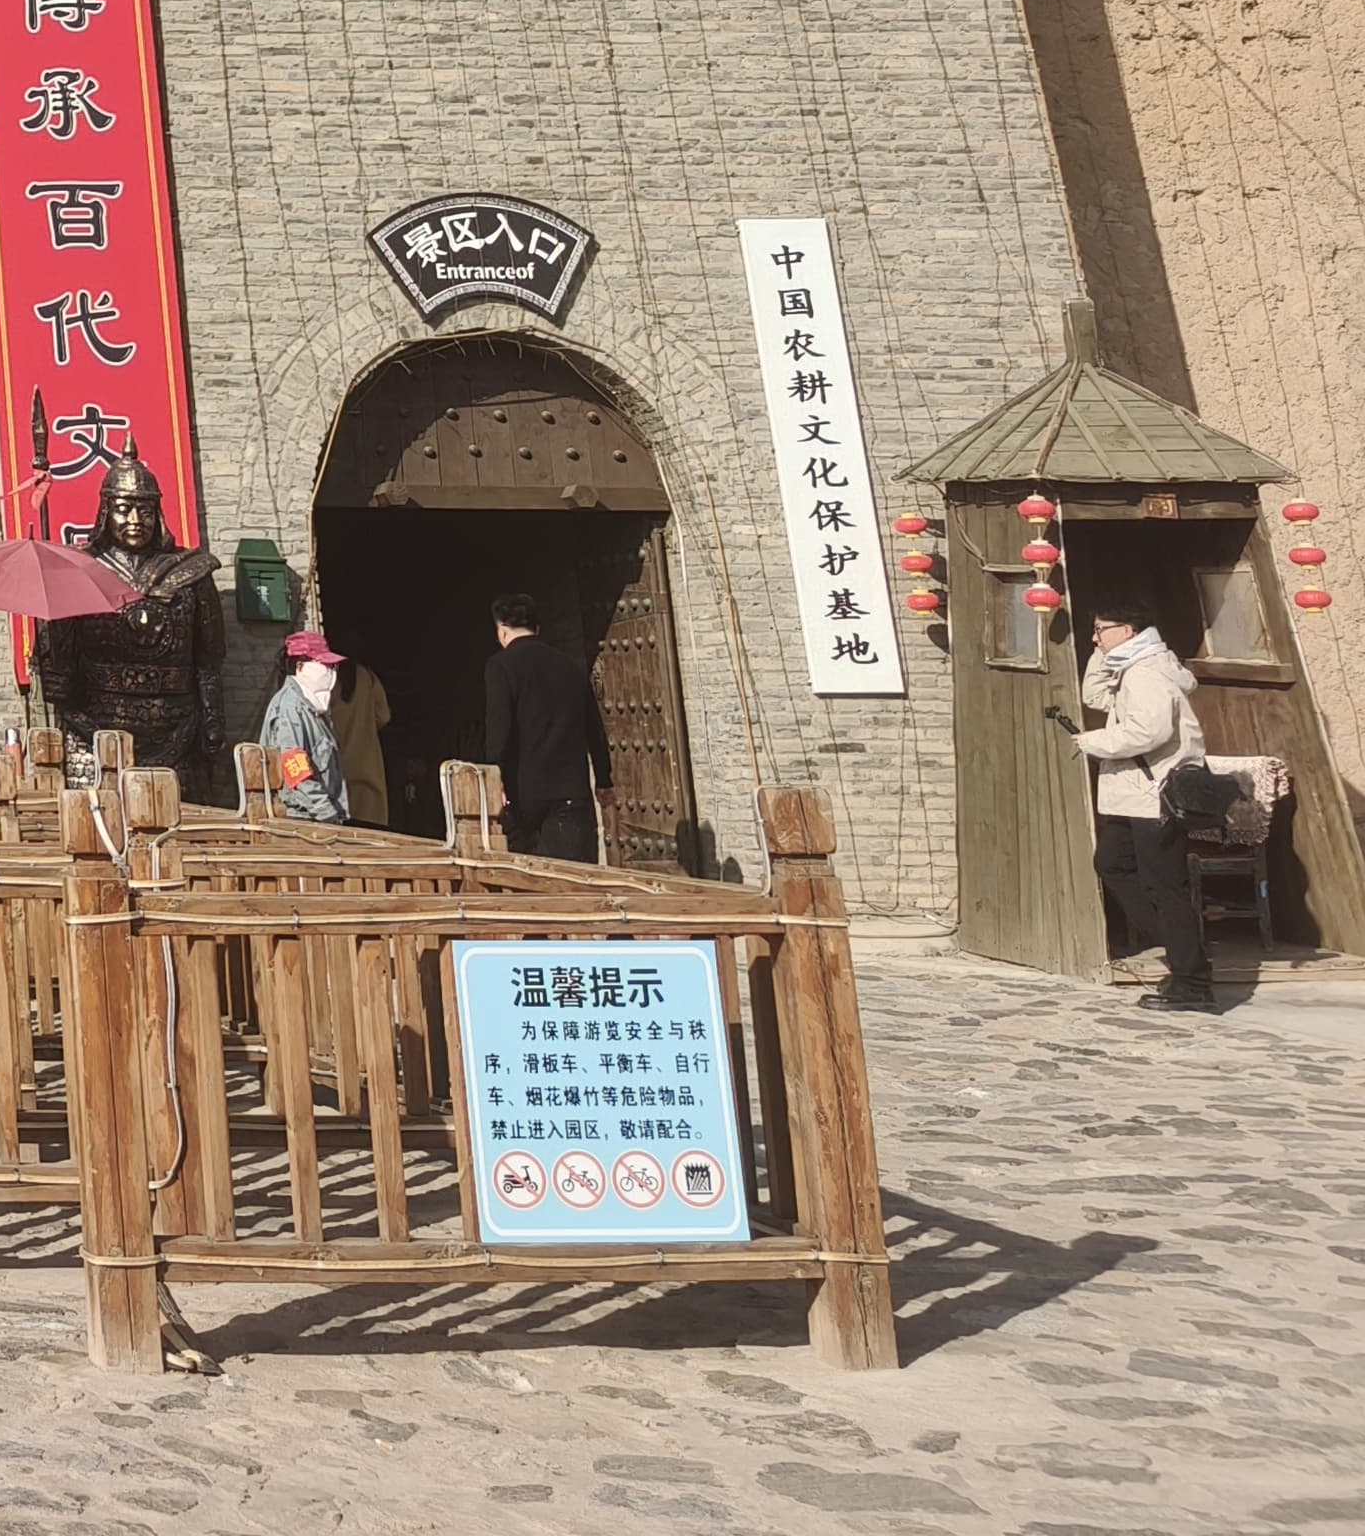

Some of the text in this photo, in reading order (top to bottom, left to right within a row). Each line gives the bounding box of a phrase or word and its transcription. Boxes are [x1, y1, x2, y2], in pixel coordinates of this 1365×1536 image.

[403, 212, 566, 268] 景区入口
[435, 262, 536, 280] Entranceof
[770, 244, 879, 665] 中国农耕文化保护基地
[510, 966, 665, 1009] 温馨提示
[521, 1020, 708, 1042] 为保障游览安全与秩
[484, 1052, 710, 1075] 序，滑板车、平衡车、自行
